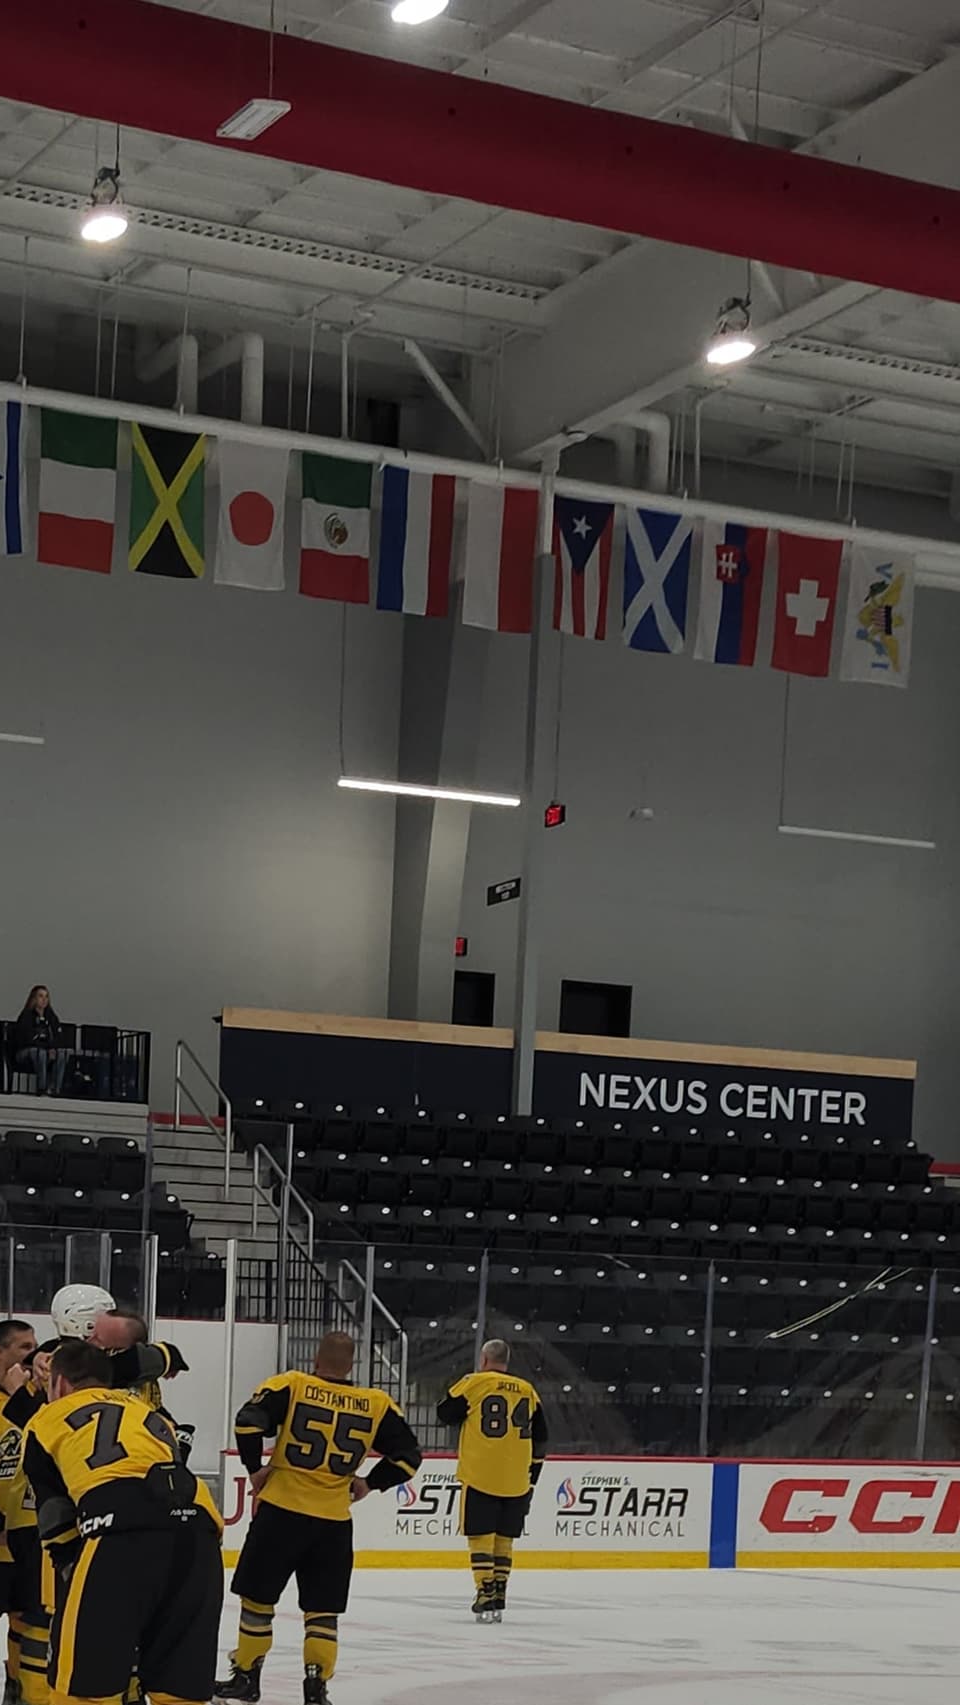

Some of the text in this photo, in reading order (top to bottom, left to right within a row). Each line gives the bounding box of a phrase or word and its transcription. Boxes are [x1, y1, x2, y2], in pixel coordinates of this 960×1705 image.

[579, 1072, 867, 1126] NEXUS CENTER
[305, 1385, 370, 1412] COSTANTINO
[480, 1394, 530, 1439] 84
[285, 1402, 373, 1477] 55
[423, 1474, 457, 1483] STEPHE
[581, 1475, 620, 1486] STEPHEN
[557, 1487, 689, 1518] STARR
[555, 1519, 686, 1537] MECHANICAL
